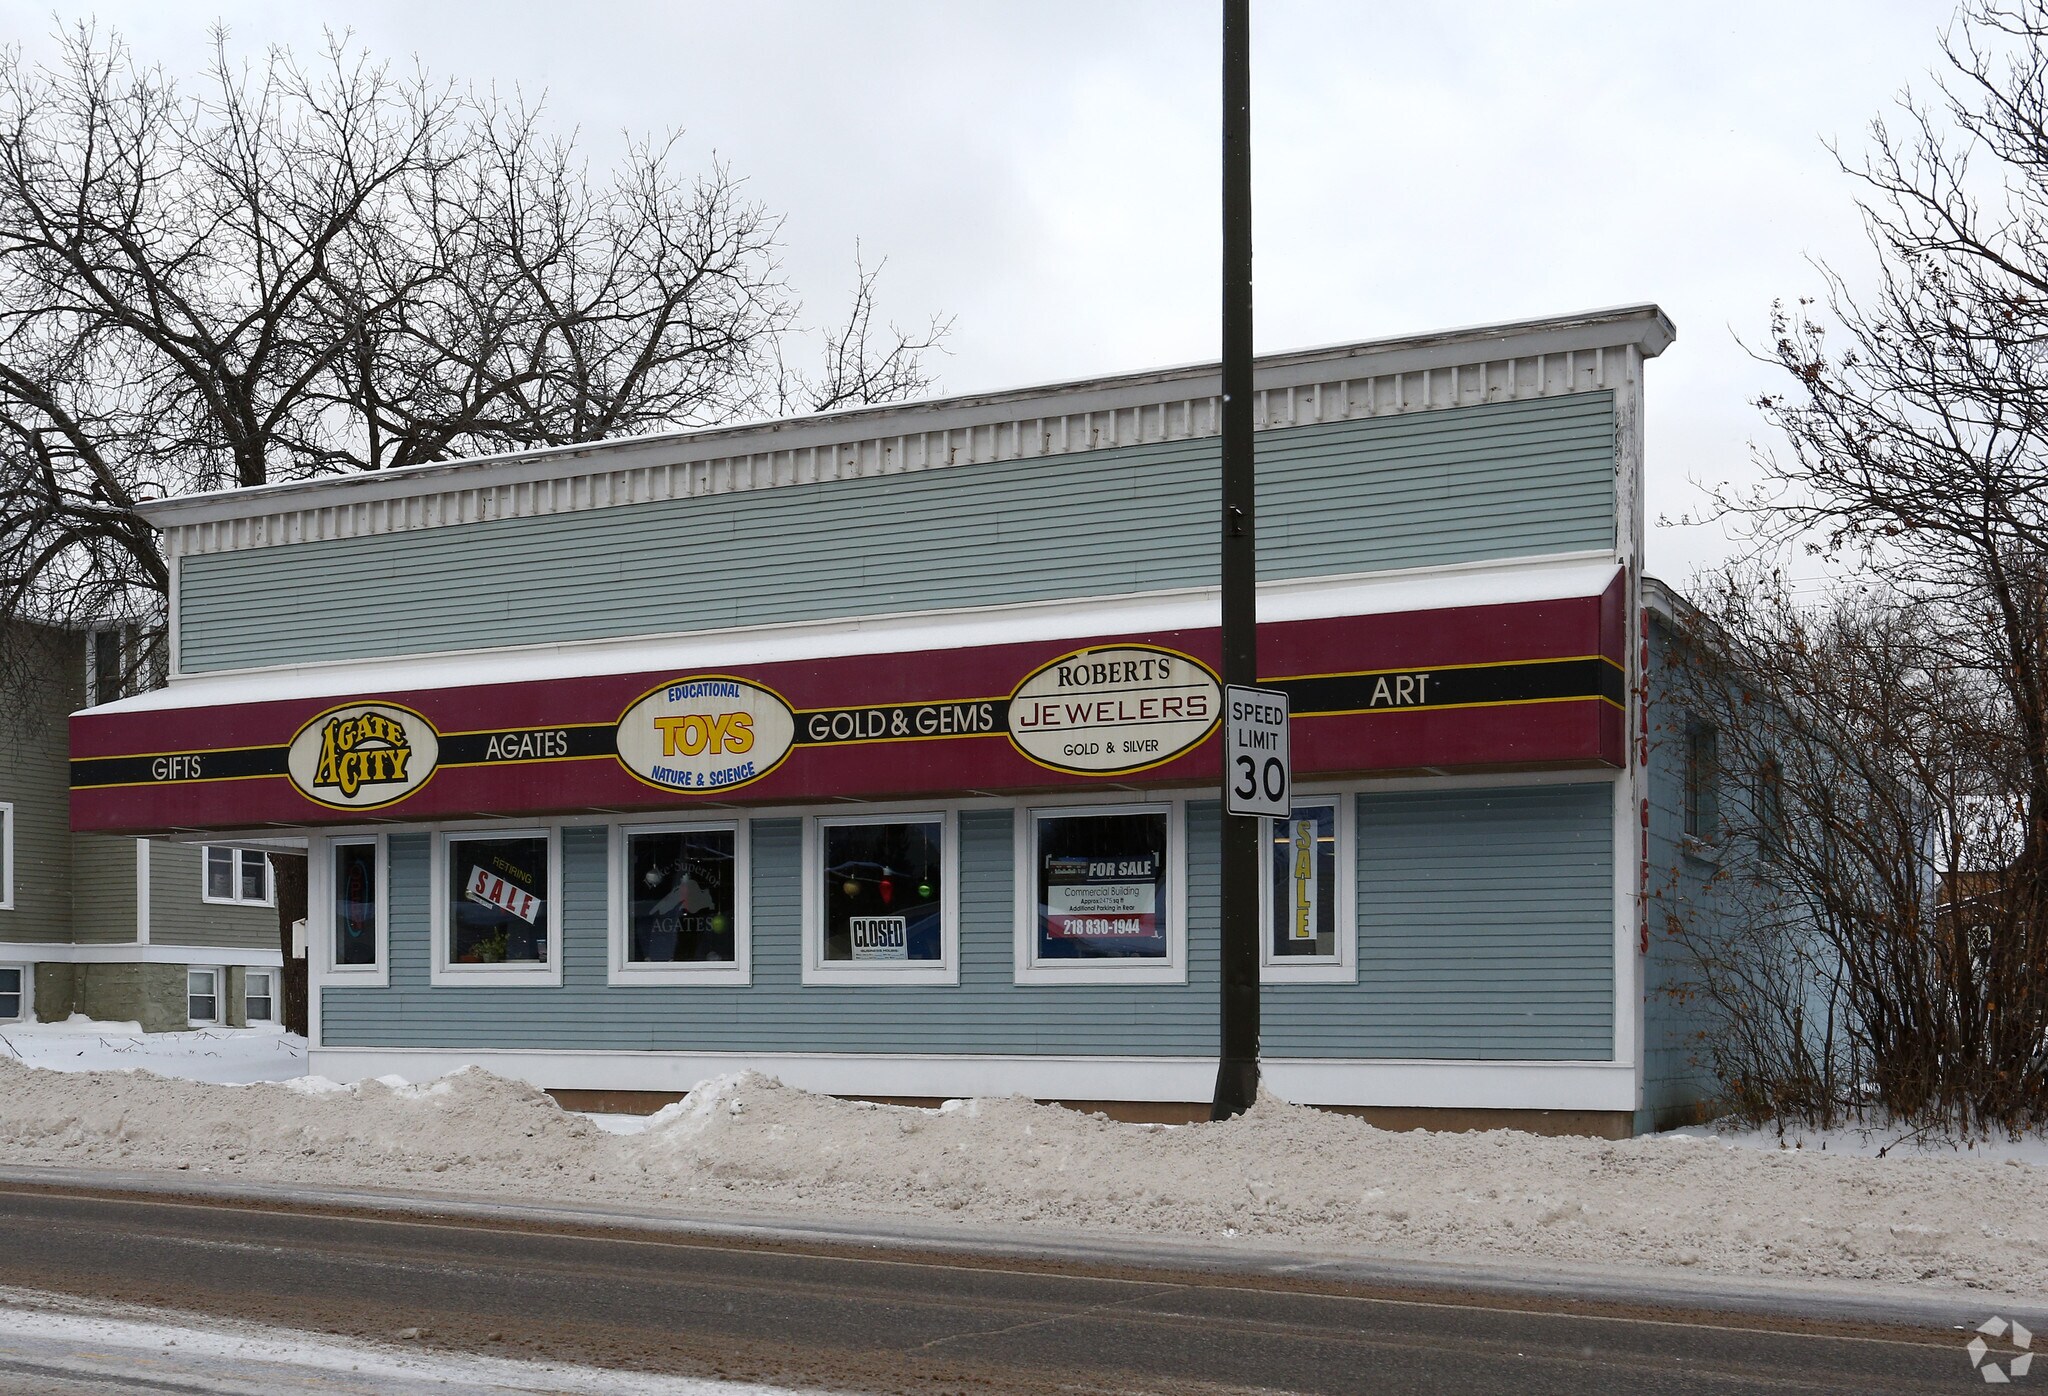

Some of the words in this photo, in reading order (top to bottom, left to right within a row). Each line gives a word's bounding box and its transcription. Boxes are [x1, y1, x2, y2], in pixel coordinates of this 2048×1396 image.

[1057, 658, 1170, 688] ROBERTS
[668, 682, 740, 703] EDUCATIONAL
[1370, 674, 1430, 707] ART
[808, 710, 887, 741] GOLD
[890, 709, 911, 736] &
[915, 703, 993, 734] GEMS
[1020, 695, 1207, 727] JEWELERS
[1232, 701, 1284, 726] SPEED
[313, 712, 407, 785] AGATE
[485, 730, 568, 760] AGATES
[654, 711, 755, 757] TOYS
[1063, 742, 1099, 756] GOLD
[1106, 741, 1115, 754] &
[1123, 739, 1159, 753] SILVER
[1238, 728, 1279, 750] LIMIT
[152, 755, 201, 780] GIFTS
[338, 748, 411, 797] CITY
[651, 765, 692, 786] NATURE
[696, 772, 705, 786] &
[709, 761, 755, 786] SCIENCE
[1234, 755, 1286, 803] 30
[492, 856, 533, 884] RETIRING
[643, 865, 672, 890] Lke
[674, 858, 721, 889] Superior
[1088, 862, 1115, 877] FOR
[1118, 860, 1151, 876] SALE
[1294, 820, 1312, 938] SALE
[1640, 796, 1649, 954] GIFTS
[475, 870, 533, 919] SALE
[1064, 886, 1109, 897] Commercial
[1111, 885, 1140, 897] Building
[651, 917, 714, 933] AGATES
[853, 920, 904, 947] CLOSED
[1063, 919, 1083, 935] 218
[1085, 919, 1140, 935] 830-1944
